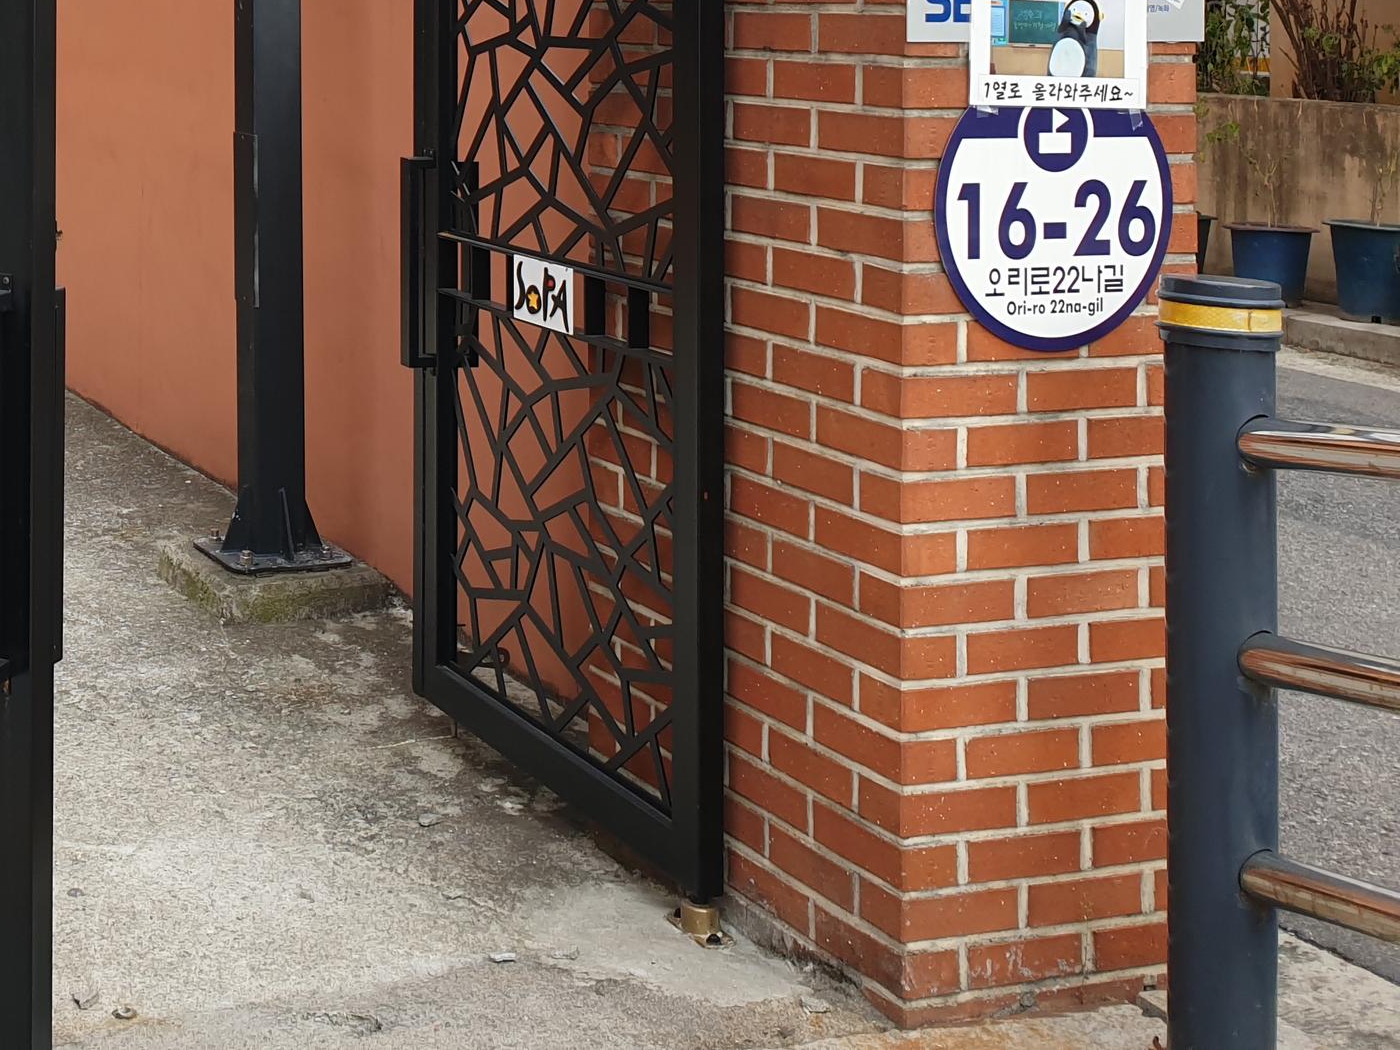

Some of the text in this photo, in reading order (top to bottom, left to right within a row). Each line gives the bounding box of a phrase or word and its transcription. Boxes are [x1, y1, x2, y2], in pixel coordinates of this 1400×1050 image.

[984, 81, 1023, 101] 1열로
[957, 179, 1157, 261] 16-26
[985, 264, 1124, 297] 오리로22나길
[1006, 297, 1103, 316] Ori-ro 22na-gil
